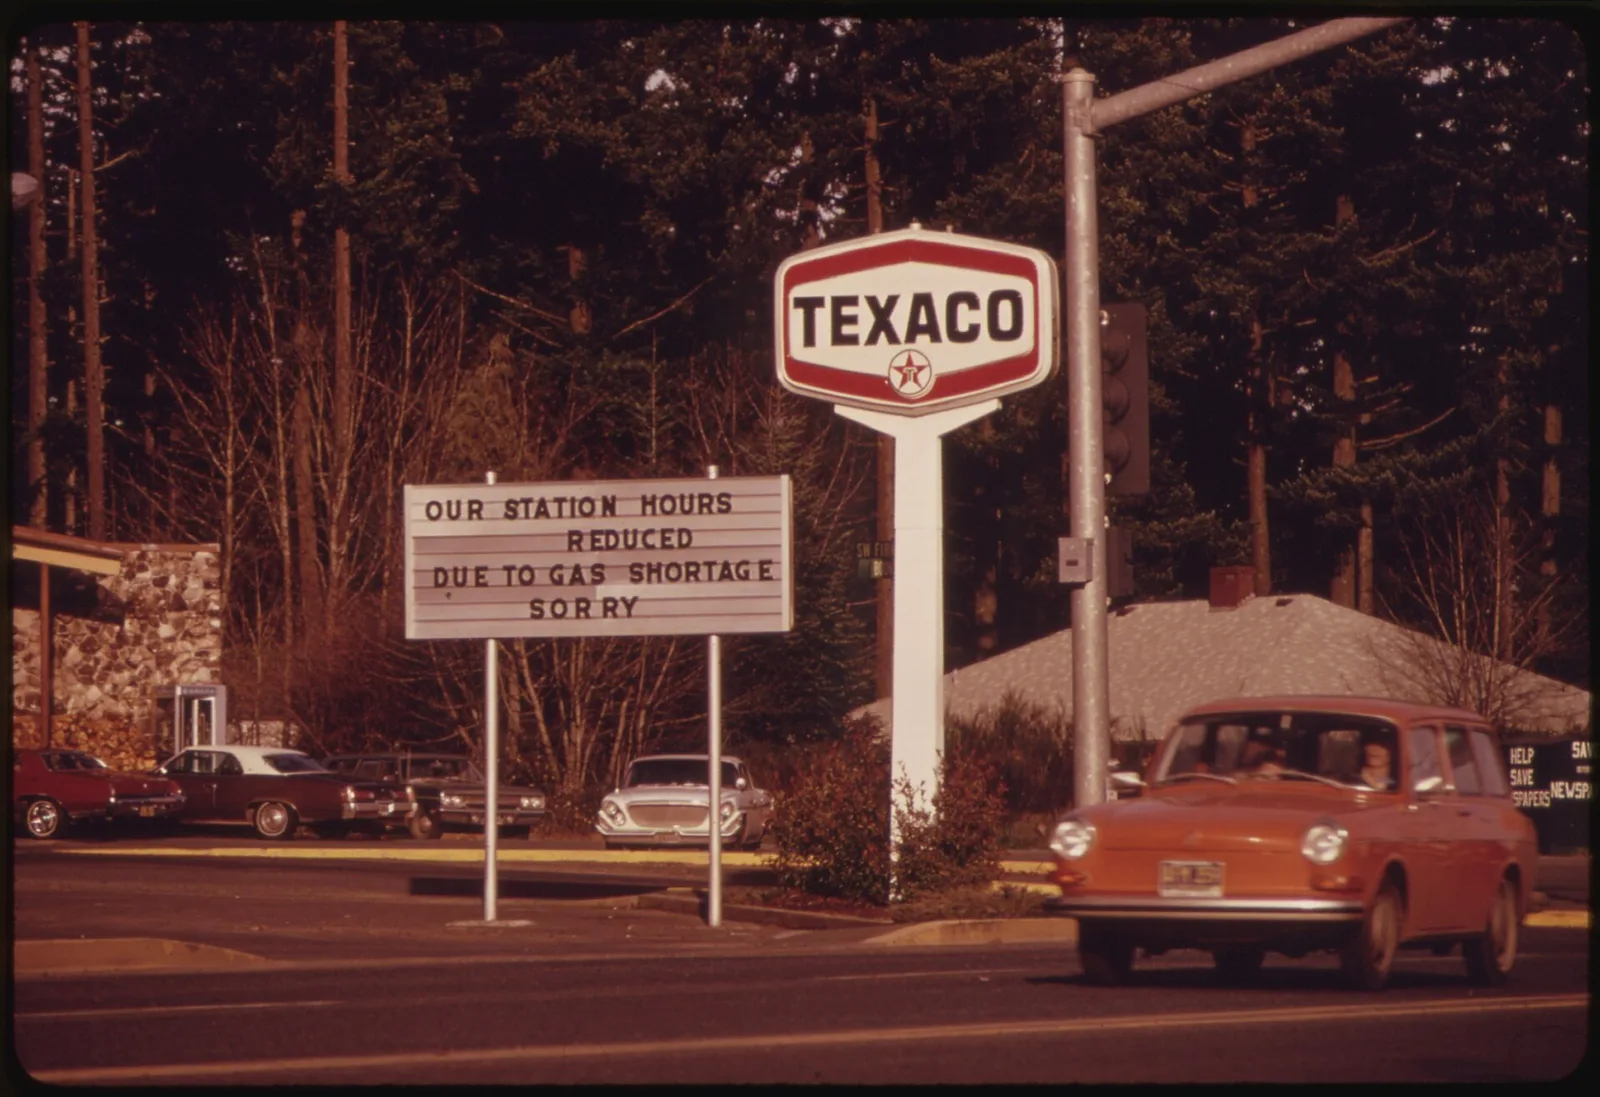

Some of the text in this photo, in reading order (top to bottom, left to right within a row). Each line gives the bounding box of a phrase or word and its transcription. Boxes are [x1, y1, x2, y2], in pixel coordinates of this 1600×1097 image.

[793, 289, 1024, 348] TEXACO
[425, 492, 733, 521] OUR STATION HOURS
[567, 528, 693, 552] REDUCED
[433, 559, 774, 588] DUE TO GAS SHORTAGE
[529, 596, 639, 620] SORRY
[1510, 747, 1535, 765] HELP
[1510, 768, 1534, 786] SAVE
